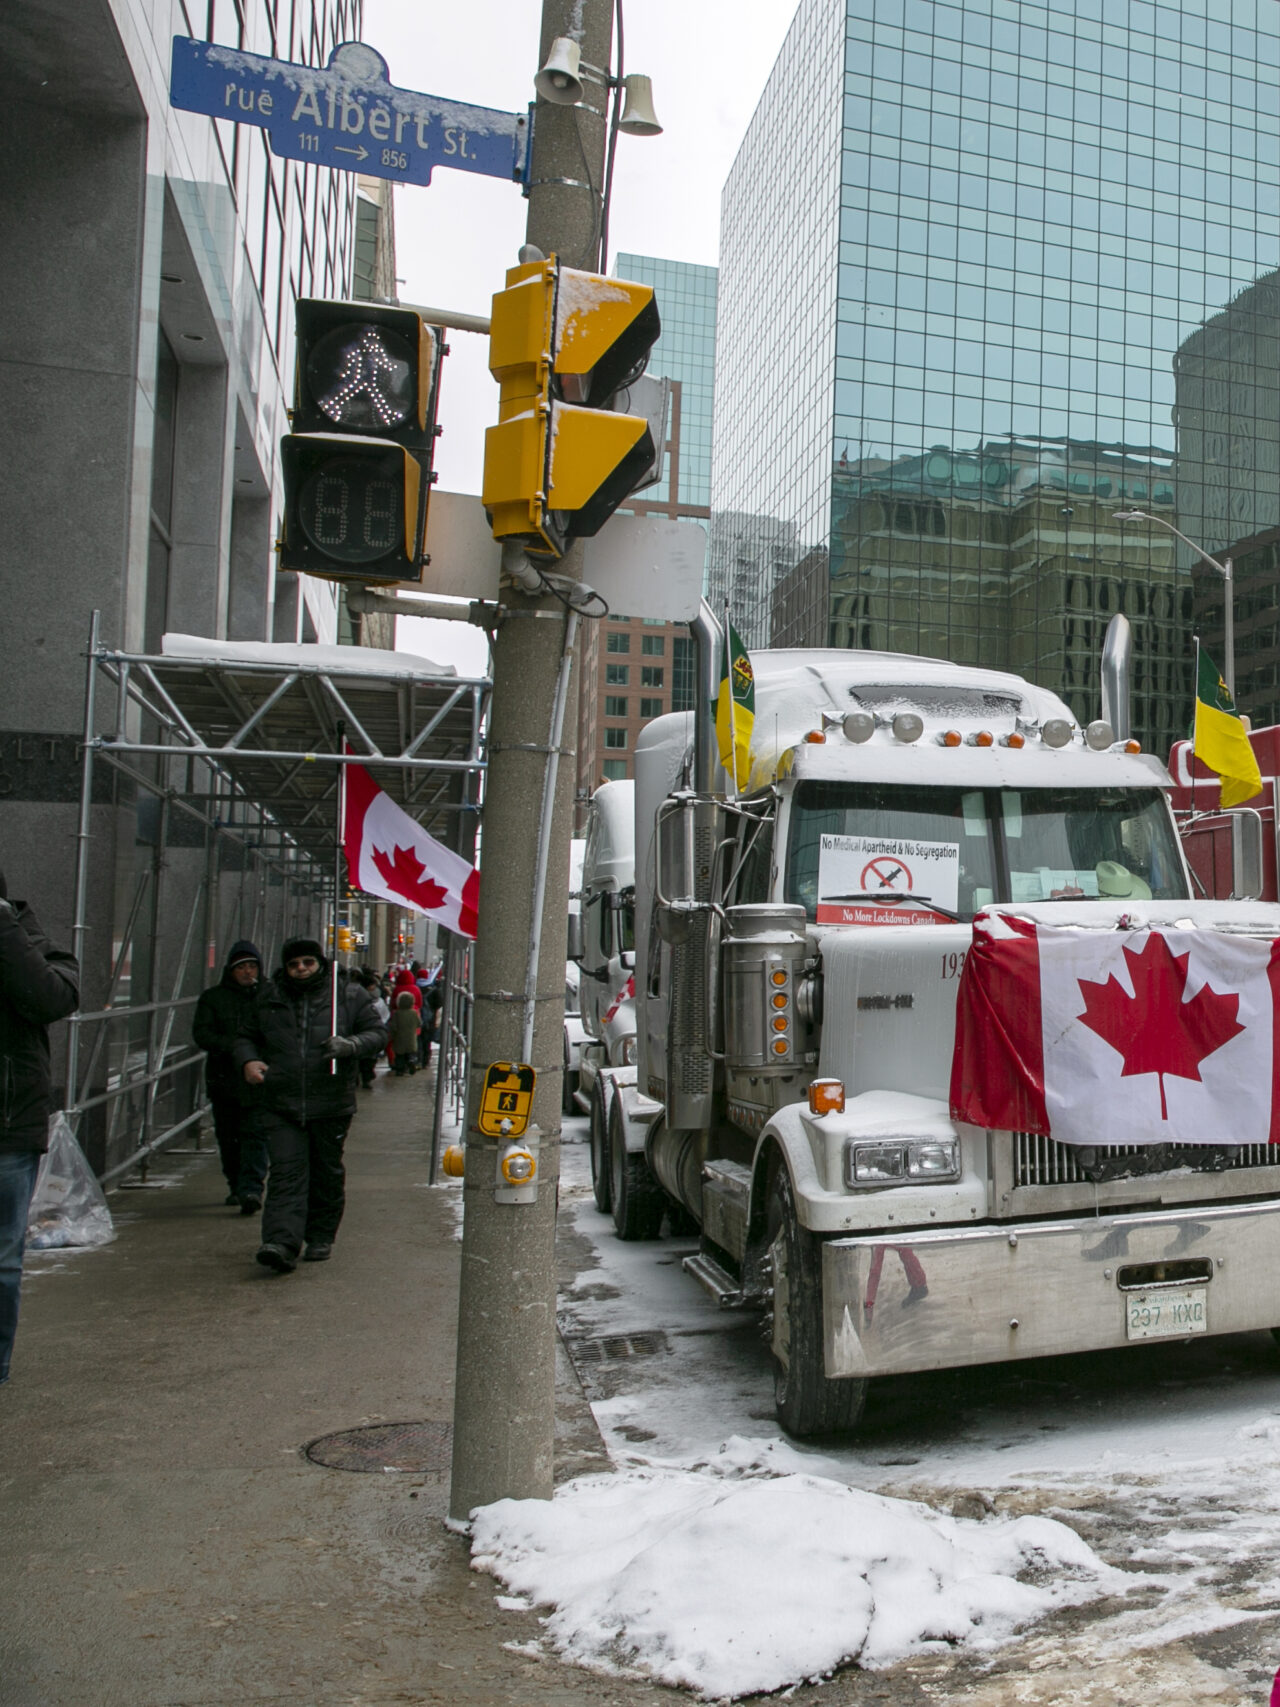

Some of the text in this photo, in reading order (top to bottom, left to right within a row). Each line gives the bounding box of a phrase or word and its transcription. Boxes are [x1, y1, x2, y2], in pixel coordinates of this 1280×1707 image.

[224, 83, 477, 160] rue Albert St.
[298, 132, 407, 170] 111 856
[822, 837, 957, 861] No Medical Apartheid & No Segregation
[842, 909, 936, 925] No More Lockdowns Canada
[1130, 1306, 1161, 1328] 237
